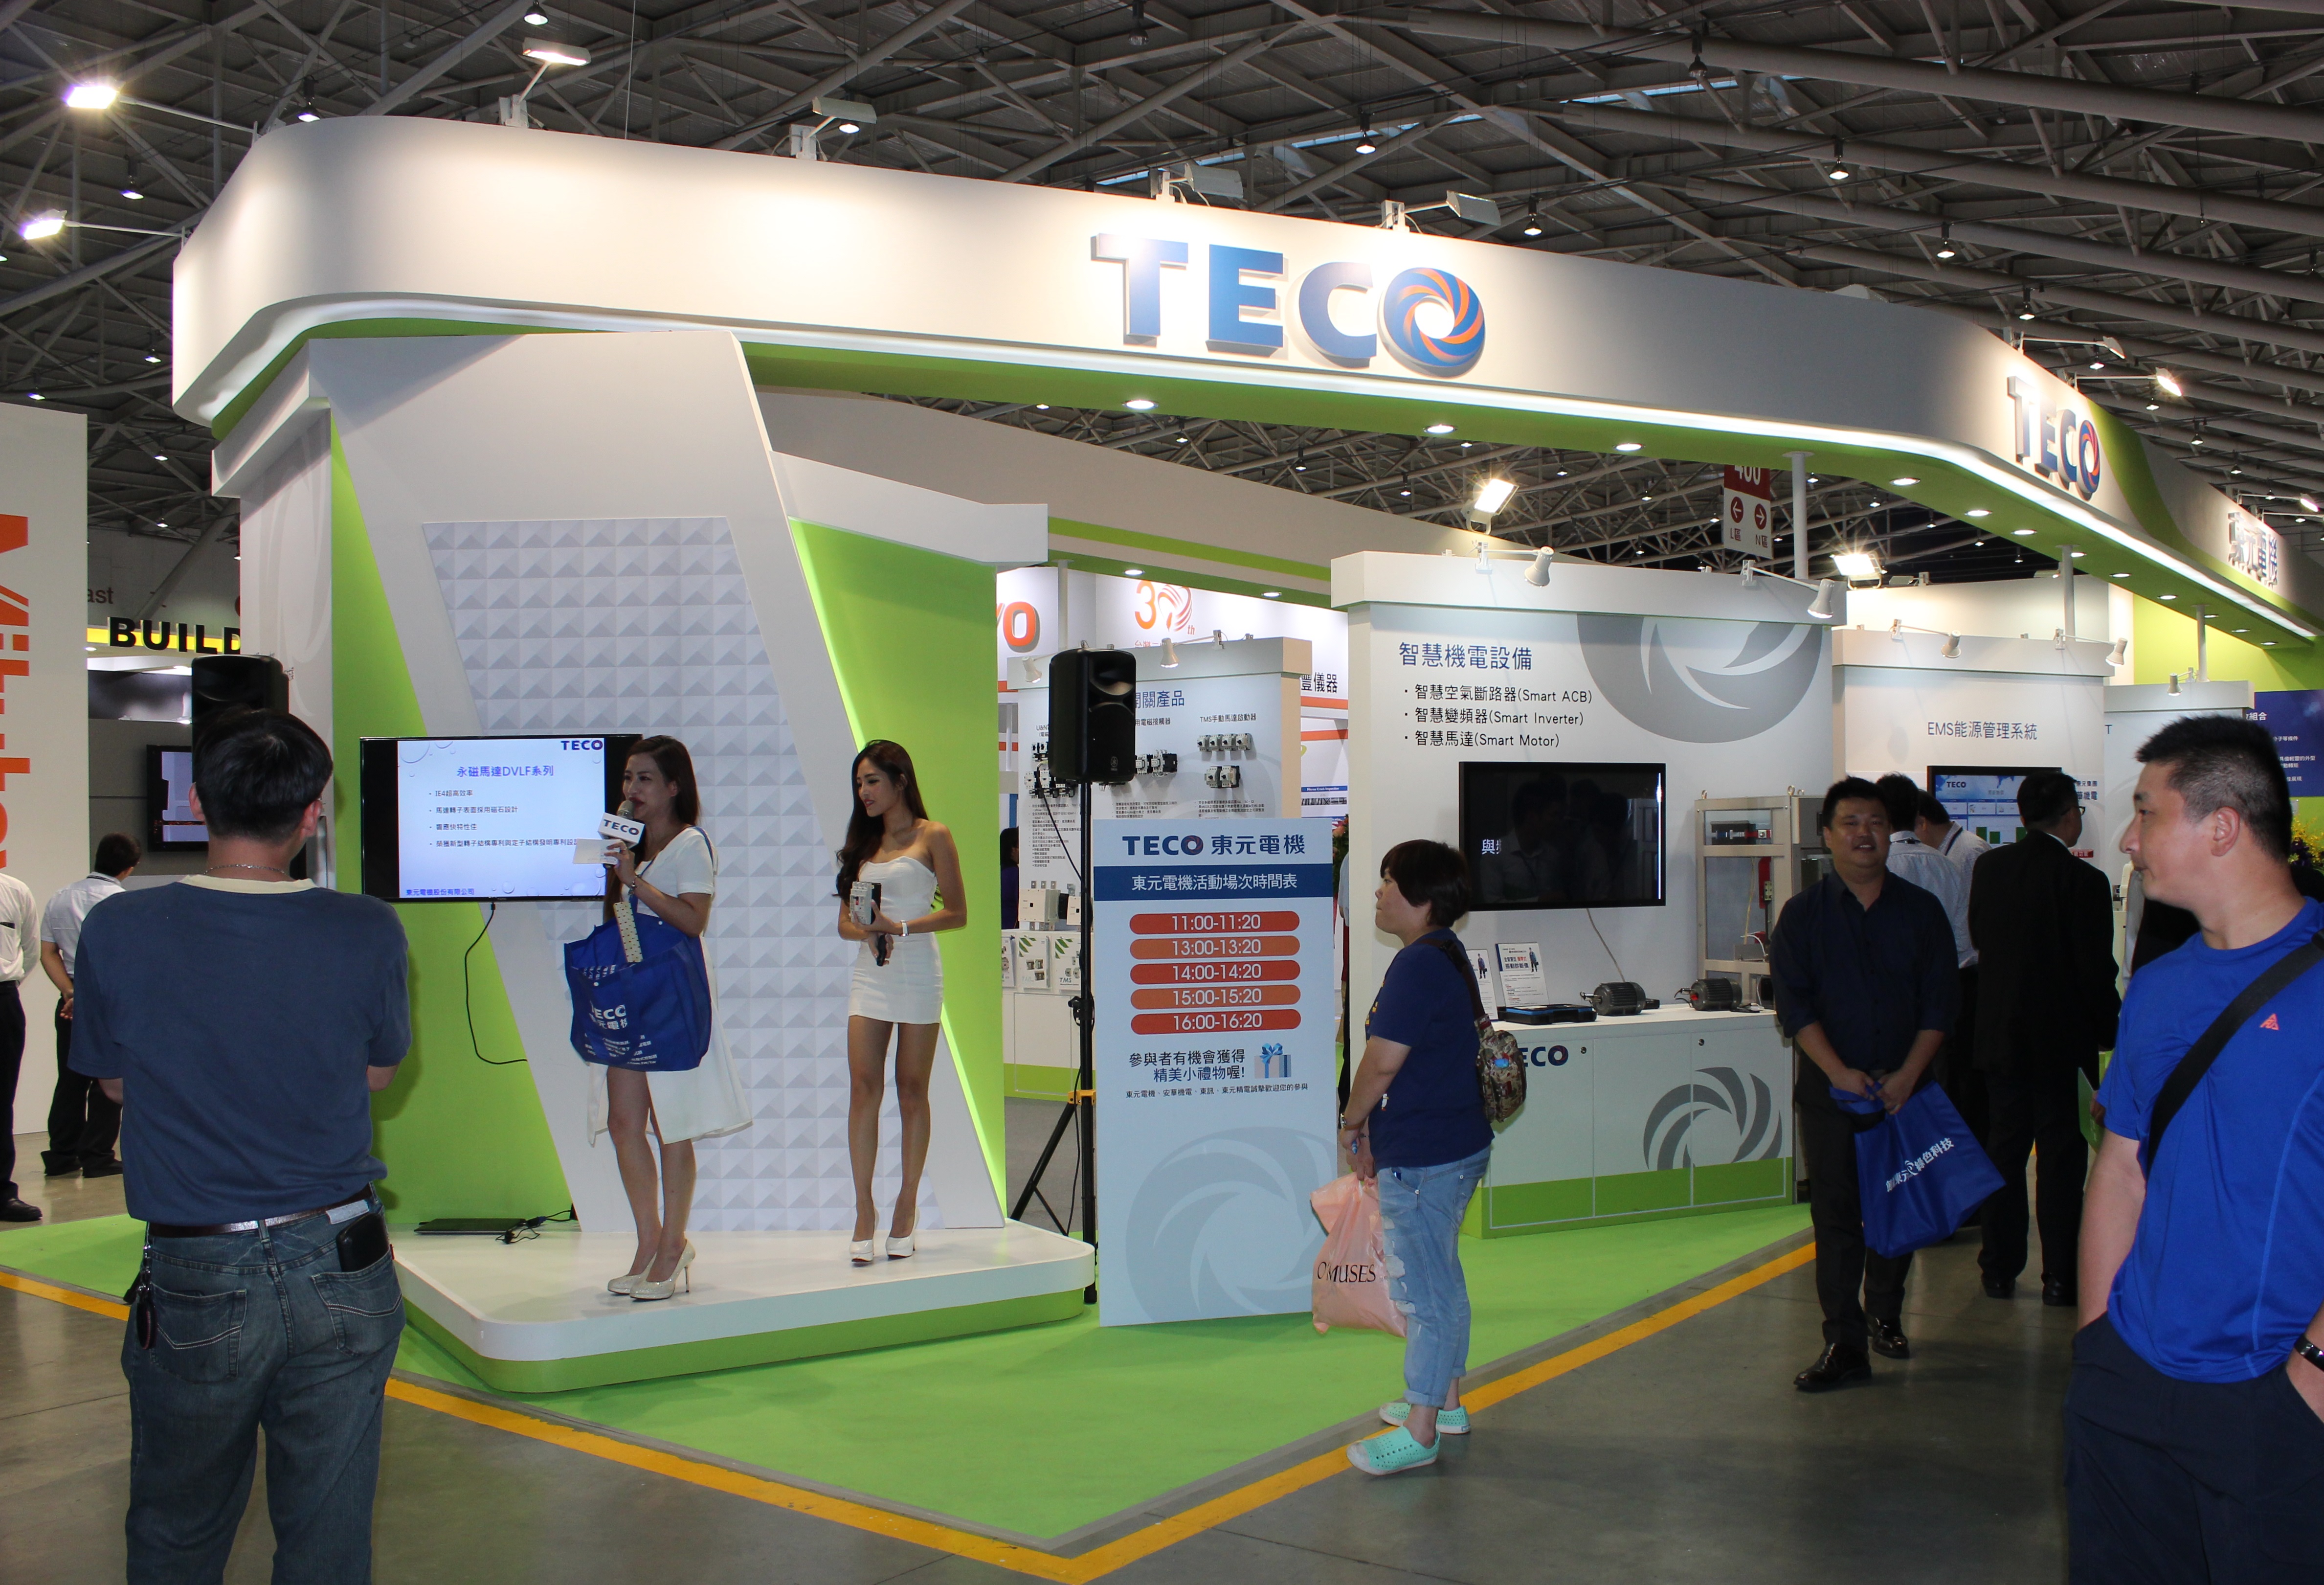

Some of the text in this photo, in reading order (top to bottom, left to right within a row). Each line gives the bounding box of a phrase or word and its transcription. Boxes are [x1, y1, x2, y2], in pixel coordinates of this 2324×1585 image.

[1093, 233, 1485, 374] TECO
[2008, 376, 2101, 497] TECO
[1730, 528, 1767, 548] L區 N區
[1399, 642, 1532, 670] 智慧機電設備
[1562, 690, 1592, 703] ACB)
[1534, 712, 1584, 725] Inverter)
[1928, 721, 2037, 740] EMS能源管理系統
[560, 740, 603, 750] TECO
[1520, 734, 1559, 747] Motor)
[457, 765, 554, 778] 永磁馬達DVLF系列
[603, 819, 639, 836] TECO
[1122, 834, 1305, 856] TECO 東元電機
[1132, 873, 1298, 891] 東元電機活動場次時間表
[1172, 914, 1261, 931] 11:00-11:20
[1172, 939, 1261, 956] 13:00-13:20
[1173, 963, 1262, 981] 14:00-14:20
[1173, 988, 1262, 1005] 15:00-15:20
[1173, 1013, 1263, 1030] 16:00-16:20
[1129, 1049, 1245, 1067] 參與者有機會獲得
[1154, 1065, 1245, 1083] 精美小禮物喔!
